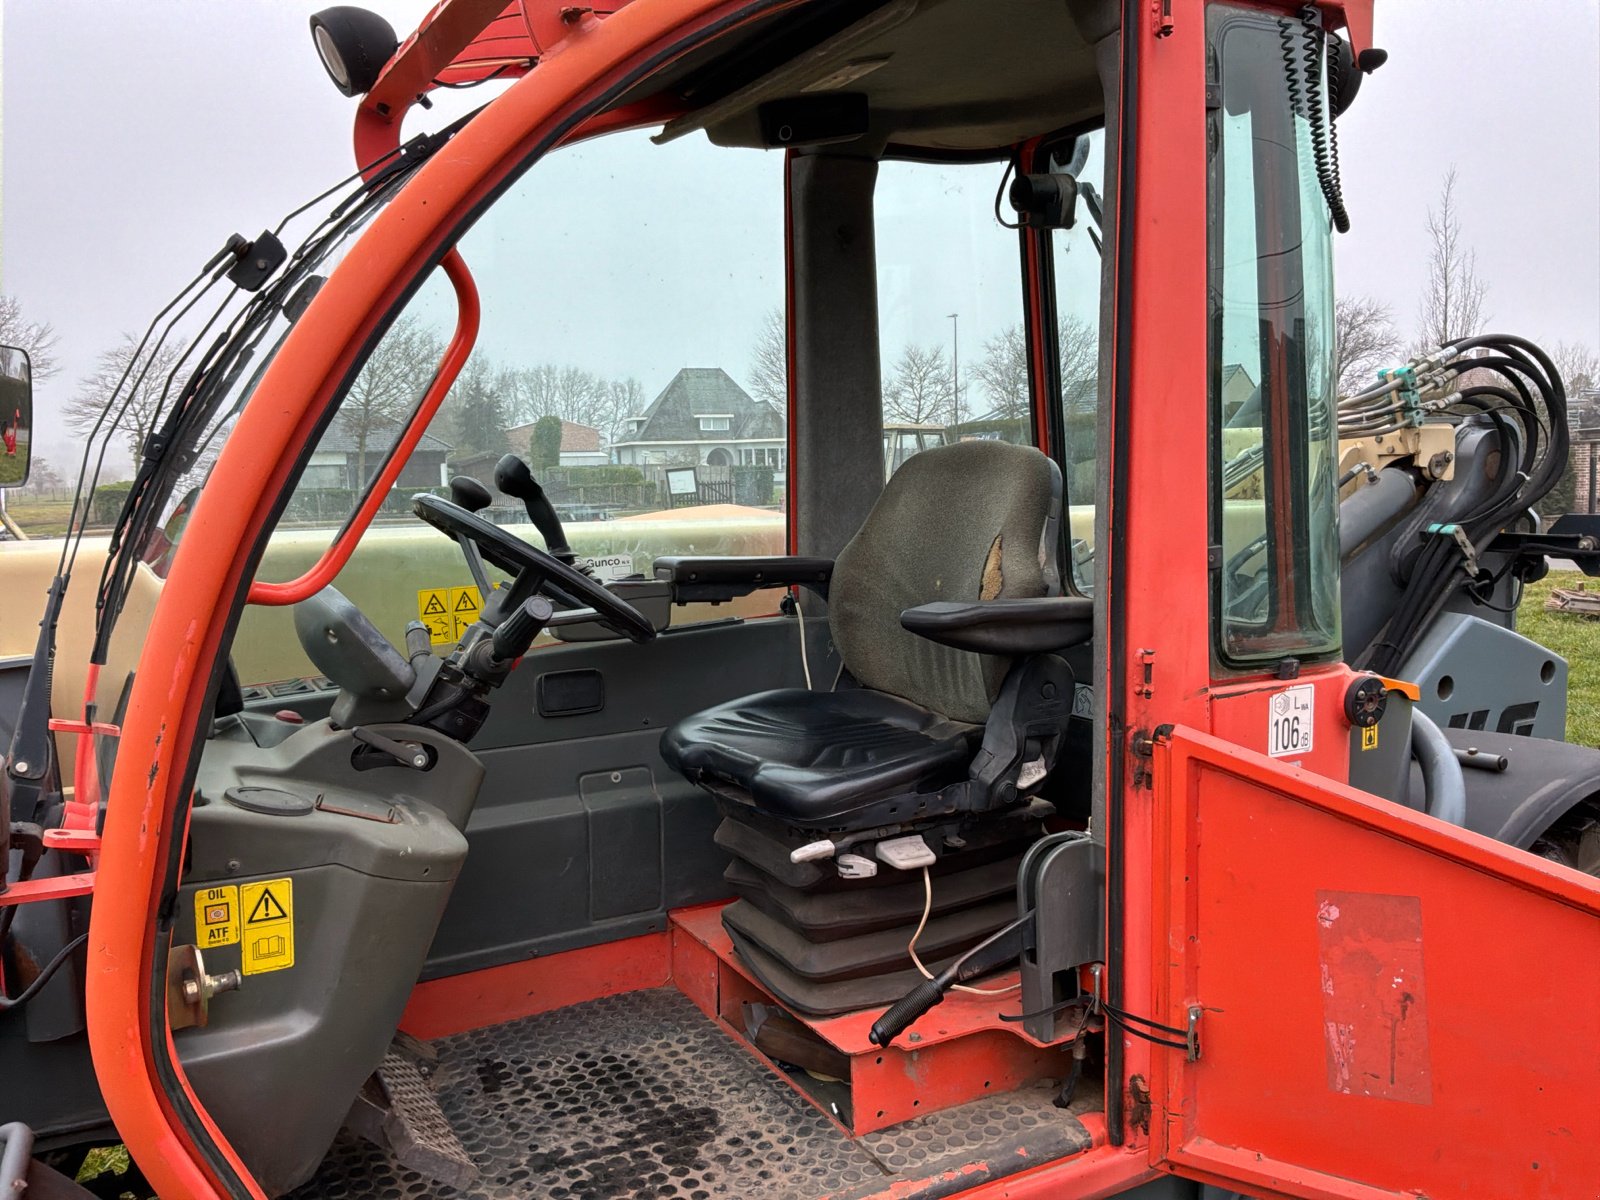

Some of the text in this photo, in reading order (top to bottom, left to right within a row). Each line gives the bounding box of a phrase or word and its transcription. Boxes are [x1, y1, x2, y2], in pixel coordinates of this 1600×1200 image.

[586, 558, 620, 568] Gunco
[1274, 716, 1309, 751] 106 dB
[208, 888, 226, 900] OIL
[208, 927, 229, 940] ATF
